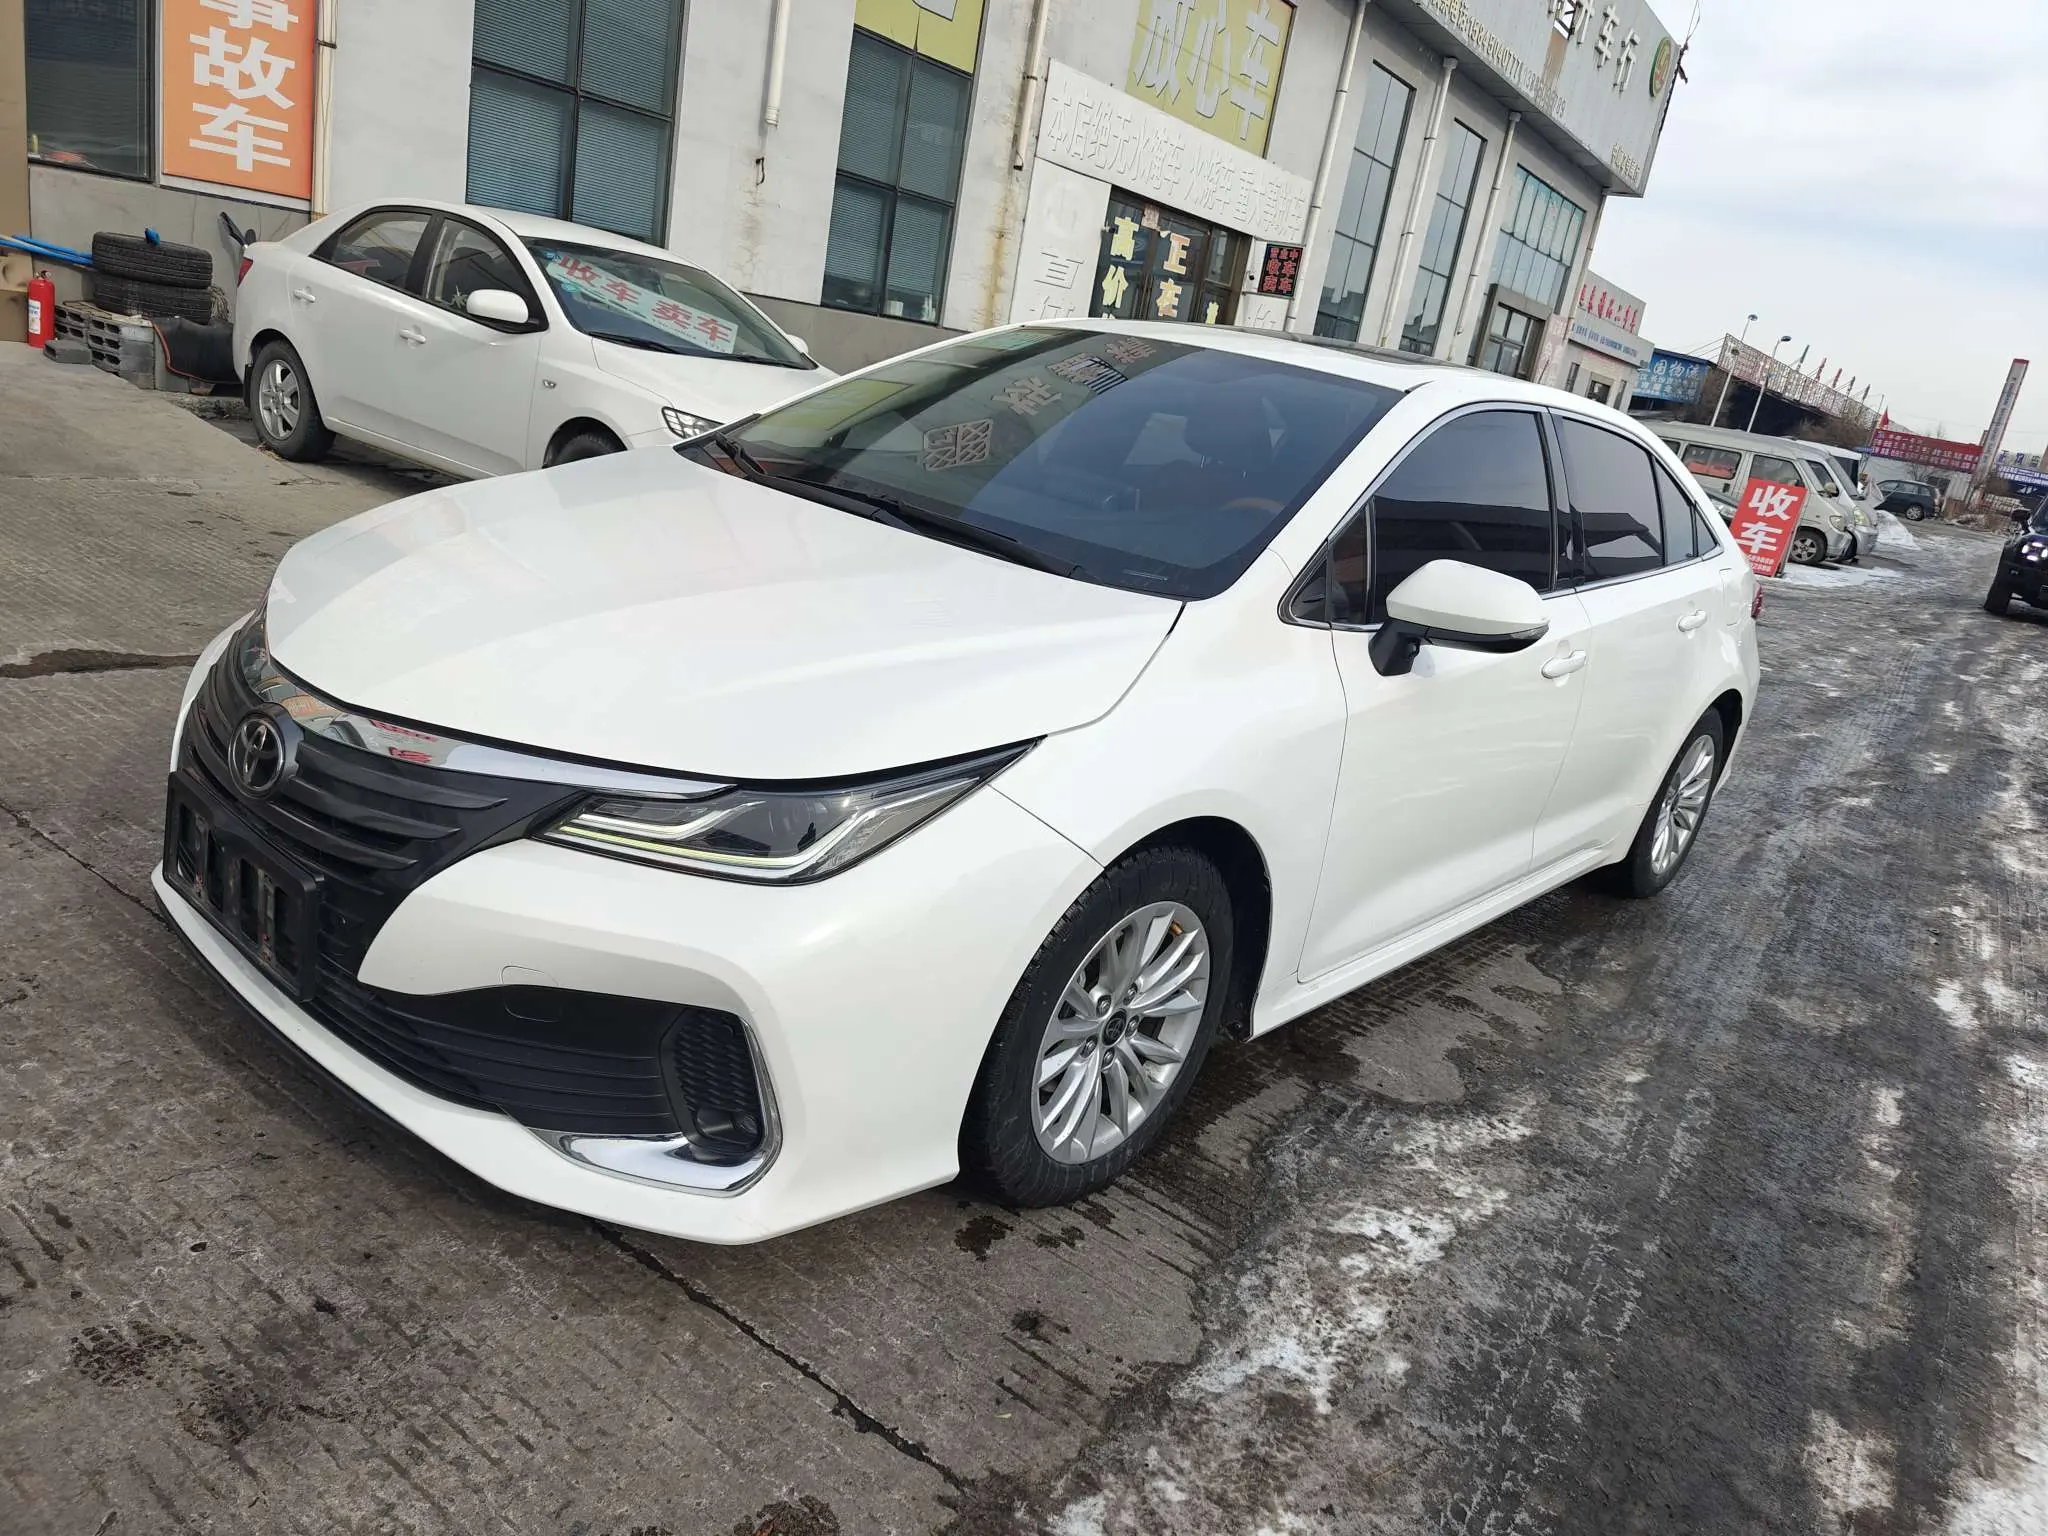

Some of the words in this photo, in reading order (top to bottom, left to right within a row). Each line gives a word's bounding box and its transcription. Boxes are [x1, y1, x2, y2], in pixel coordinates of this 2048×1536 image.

[558, 253, 642, 306] 收车
[651, 298, 733, 343] 卖车
[1102, 216, 1140, 319] 高价
[1735, 485, 1799, 554] 收车
